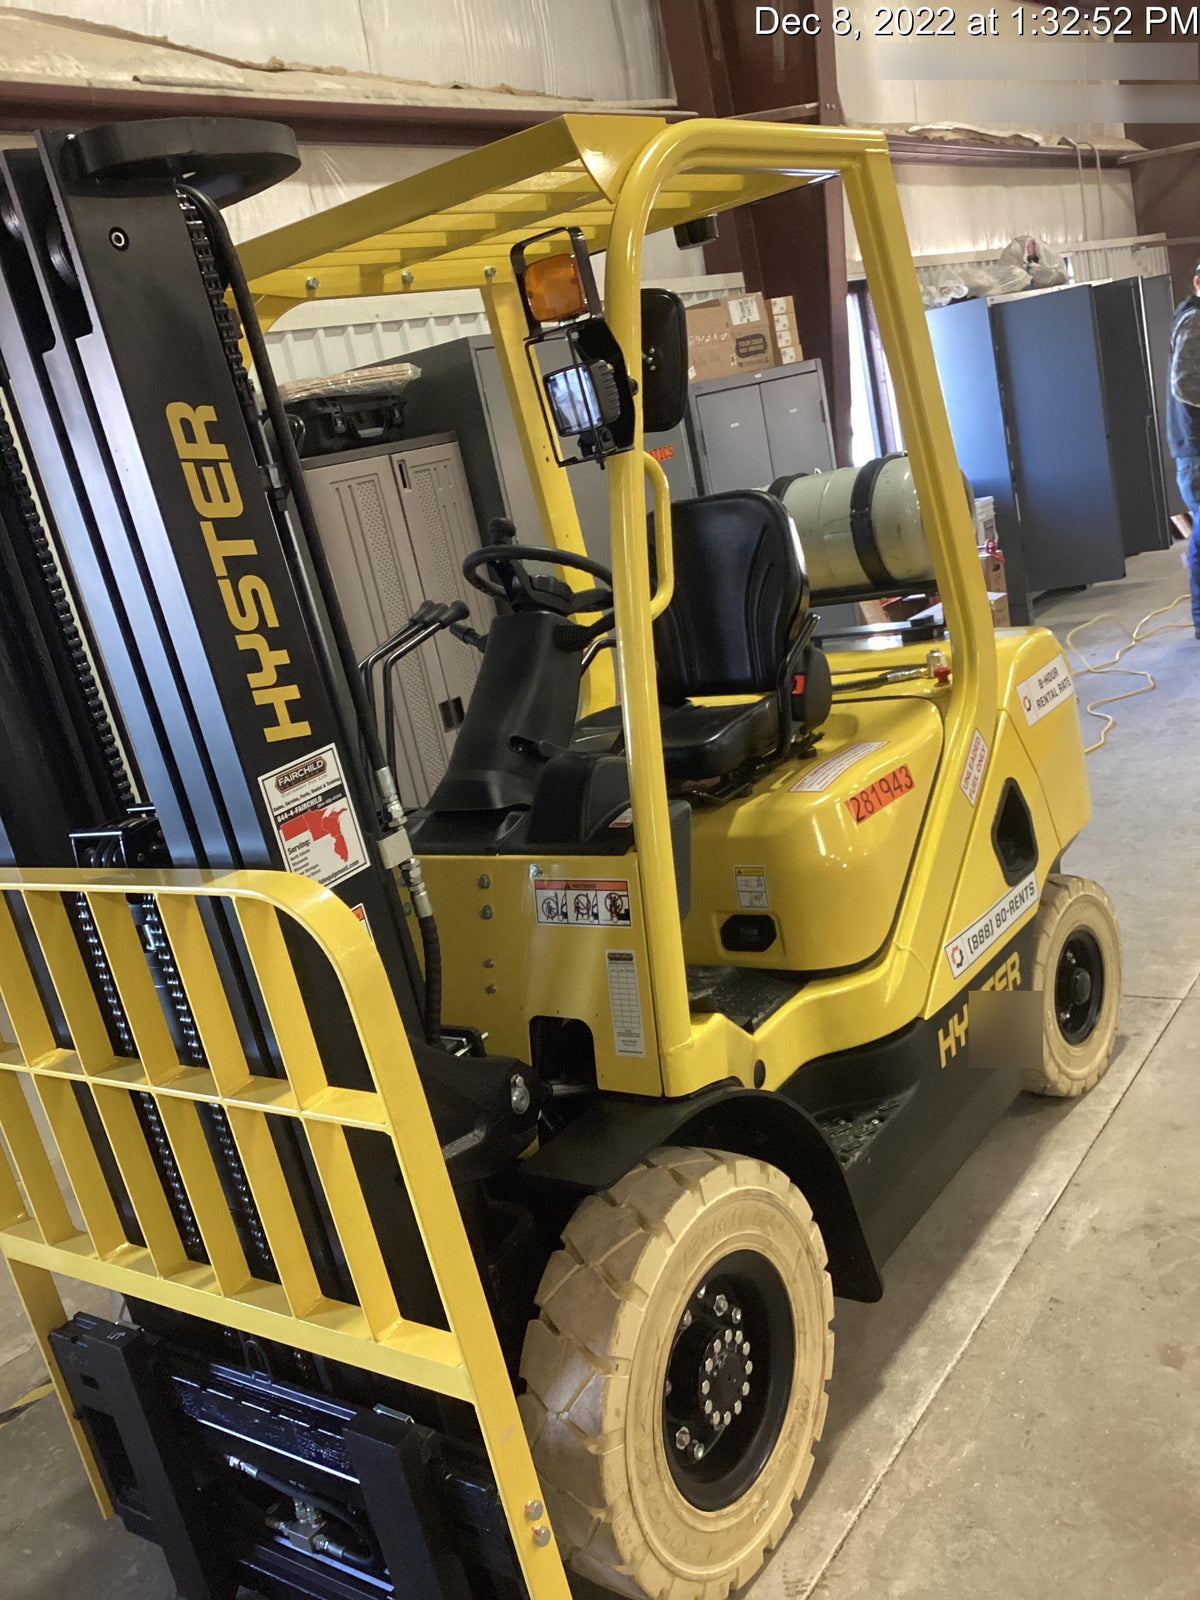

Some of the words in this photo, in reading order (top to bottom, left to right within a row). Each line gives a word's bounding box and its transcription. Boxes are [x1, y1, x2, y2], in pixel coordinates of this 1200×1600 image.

[165, 401, 312, 743] HYSTER
[1036, 688, 1059, 710] RENTAL
[1057, 676, 1071, 693] RATE
[1037, 667, 1059, 689] 8-HOUR
[278, 760, 324, 786] FAIRCHILD
[963, 736, 981, 790] UNLEADED
[969, 775, 980, 800] FUEL
[976, 745, 986, 772] ONLY
[276, 795, 323, 822] 844-4-FAIRCHILD
[850, 765, 914, 823] 281943
[967, 919, 994, 955] (888)
[995, 881, 1035, 928] 80-RENTS
[937, 951, 1021, 1069] HYTER
